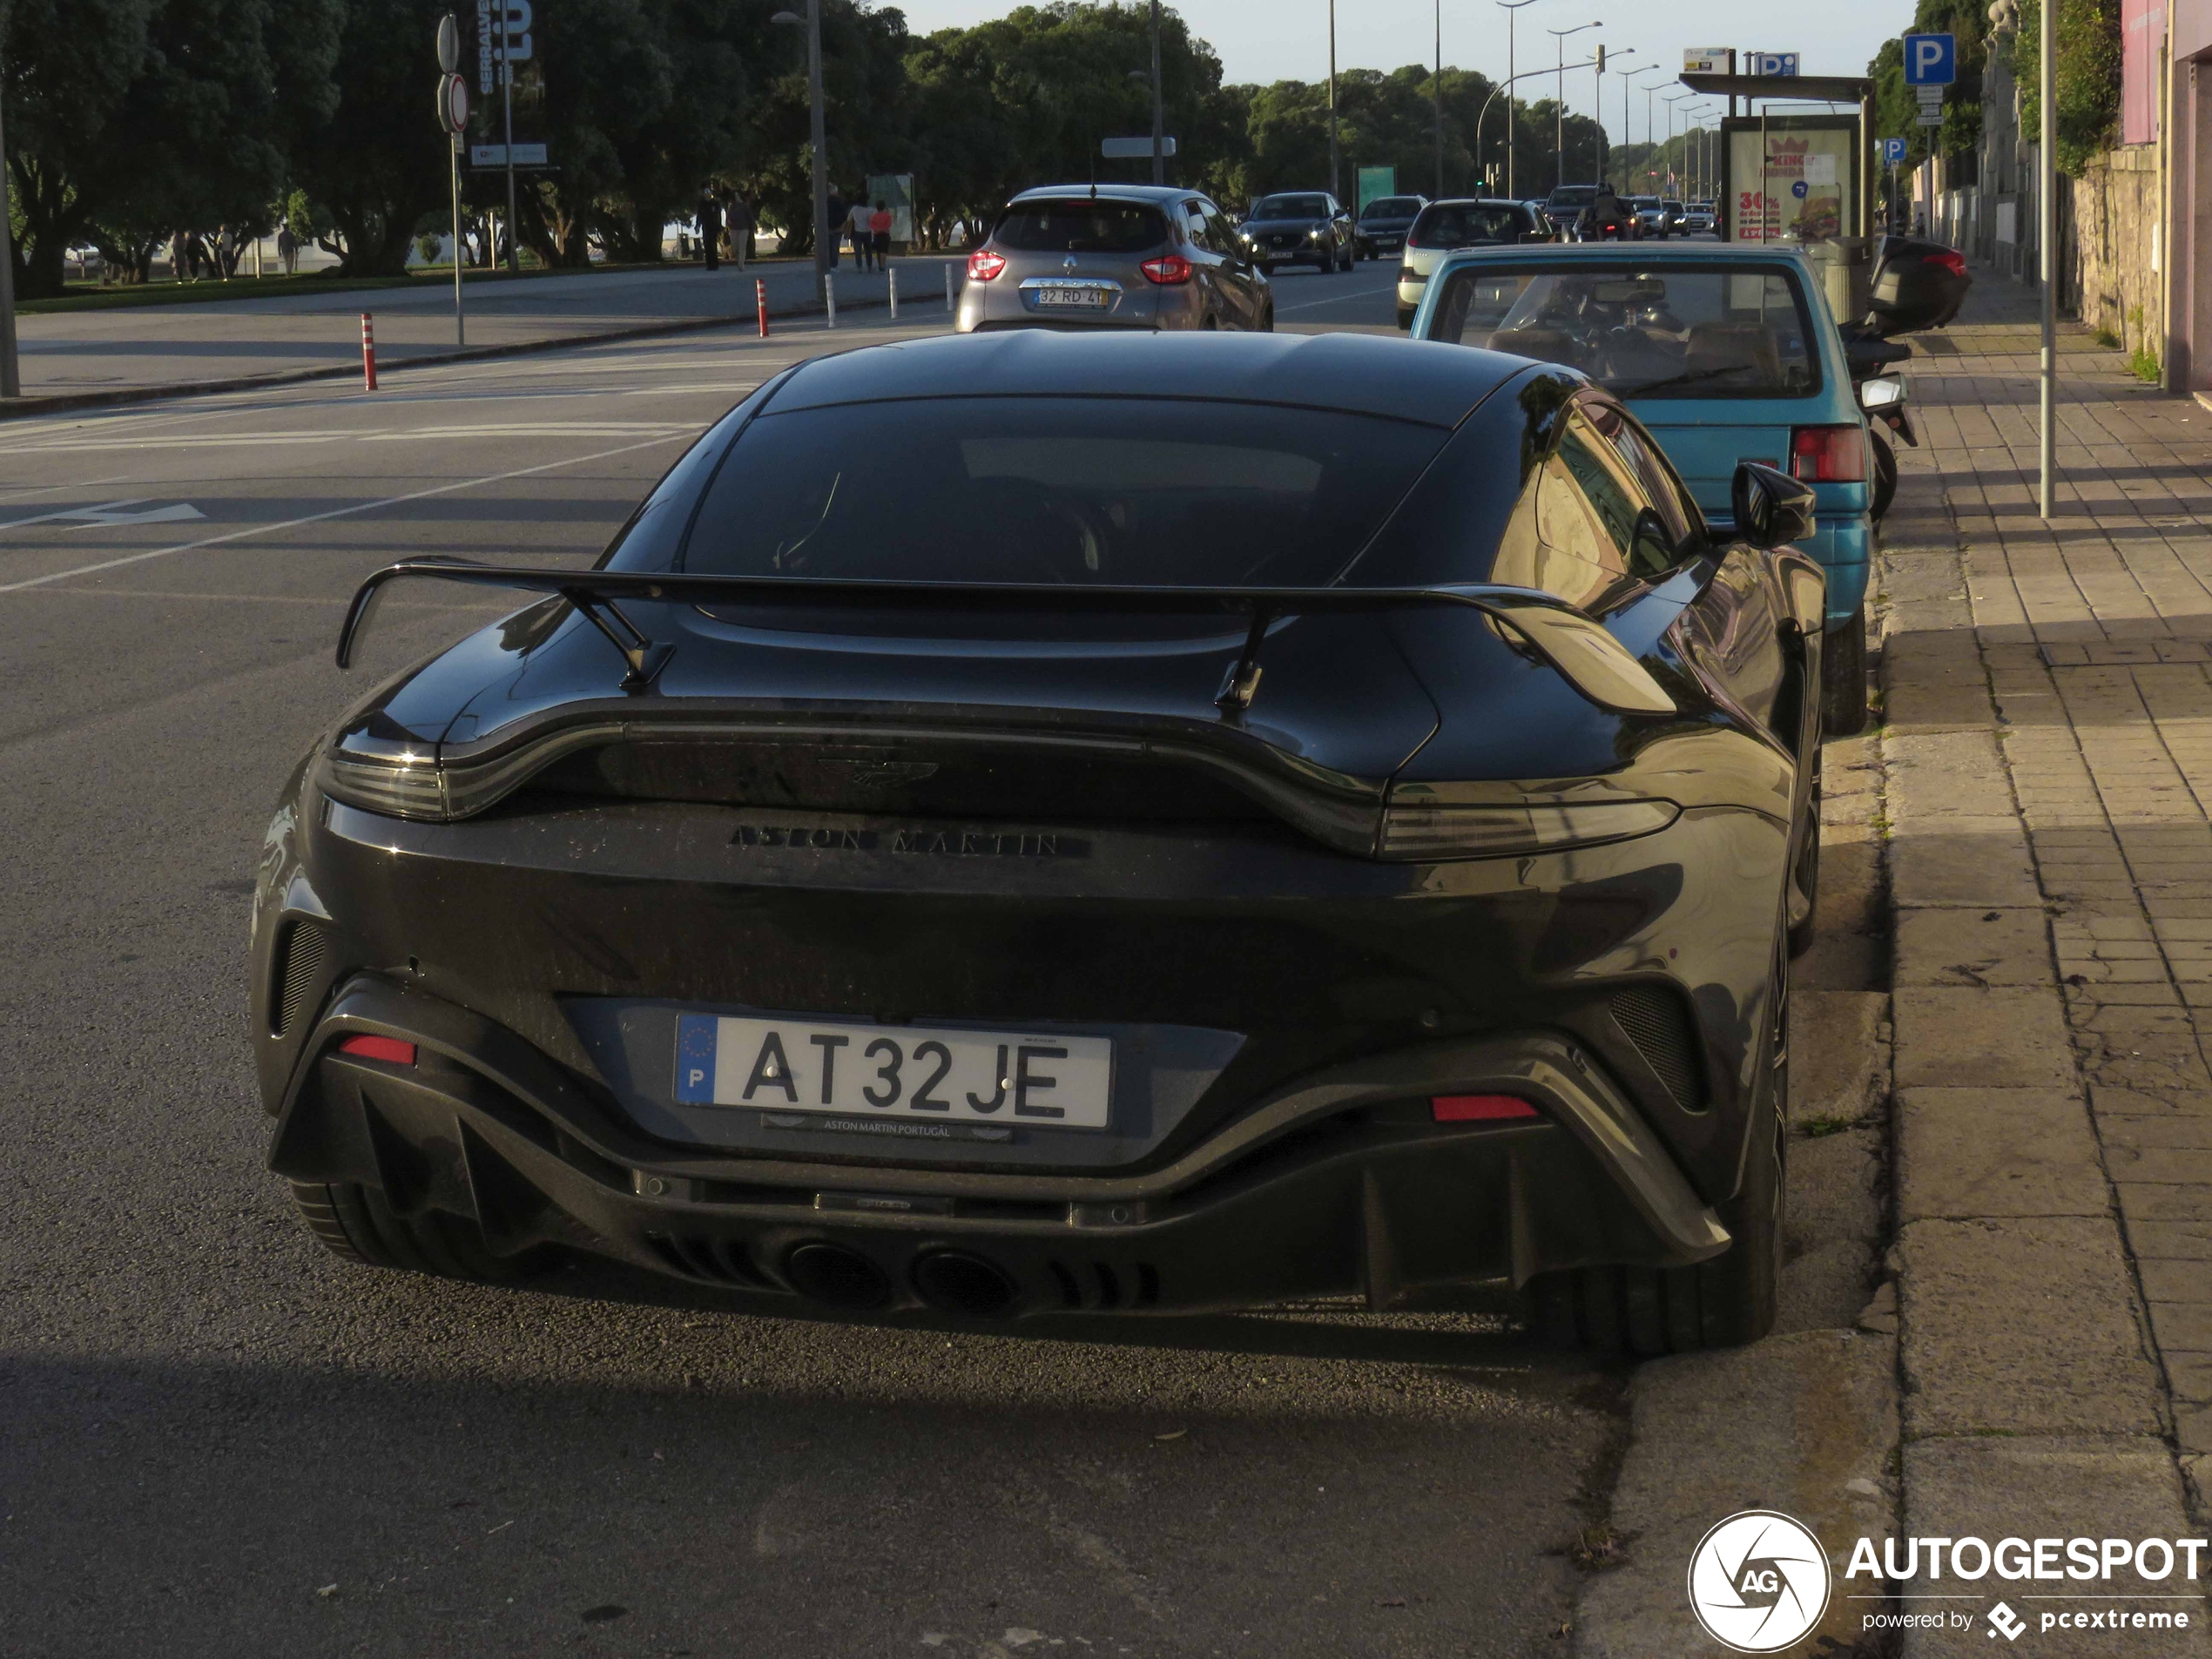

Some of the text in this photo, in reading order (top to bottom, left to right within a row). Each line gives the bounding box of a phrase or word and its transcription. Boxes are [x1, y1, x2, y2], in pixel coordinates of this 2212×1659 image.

[1917, 41, 1943, 78] P
[1889, 142, 1901, 158] P
[891, 829, 1057, 856] MARTIN
[689, 1069, 704, 1088] P
[825, 1120, 858, 1130] ASTON
[860, 1123, 897, 1133] MARTIN
